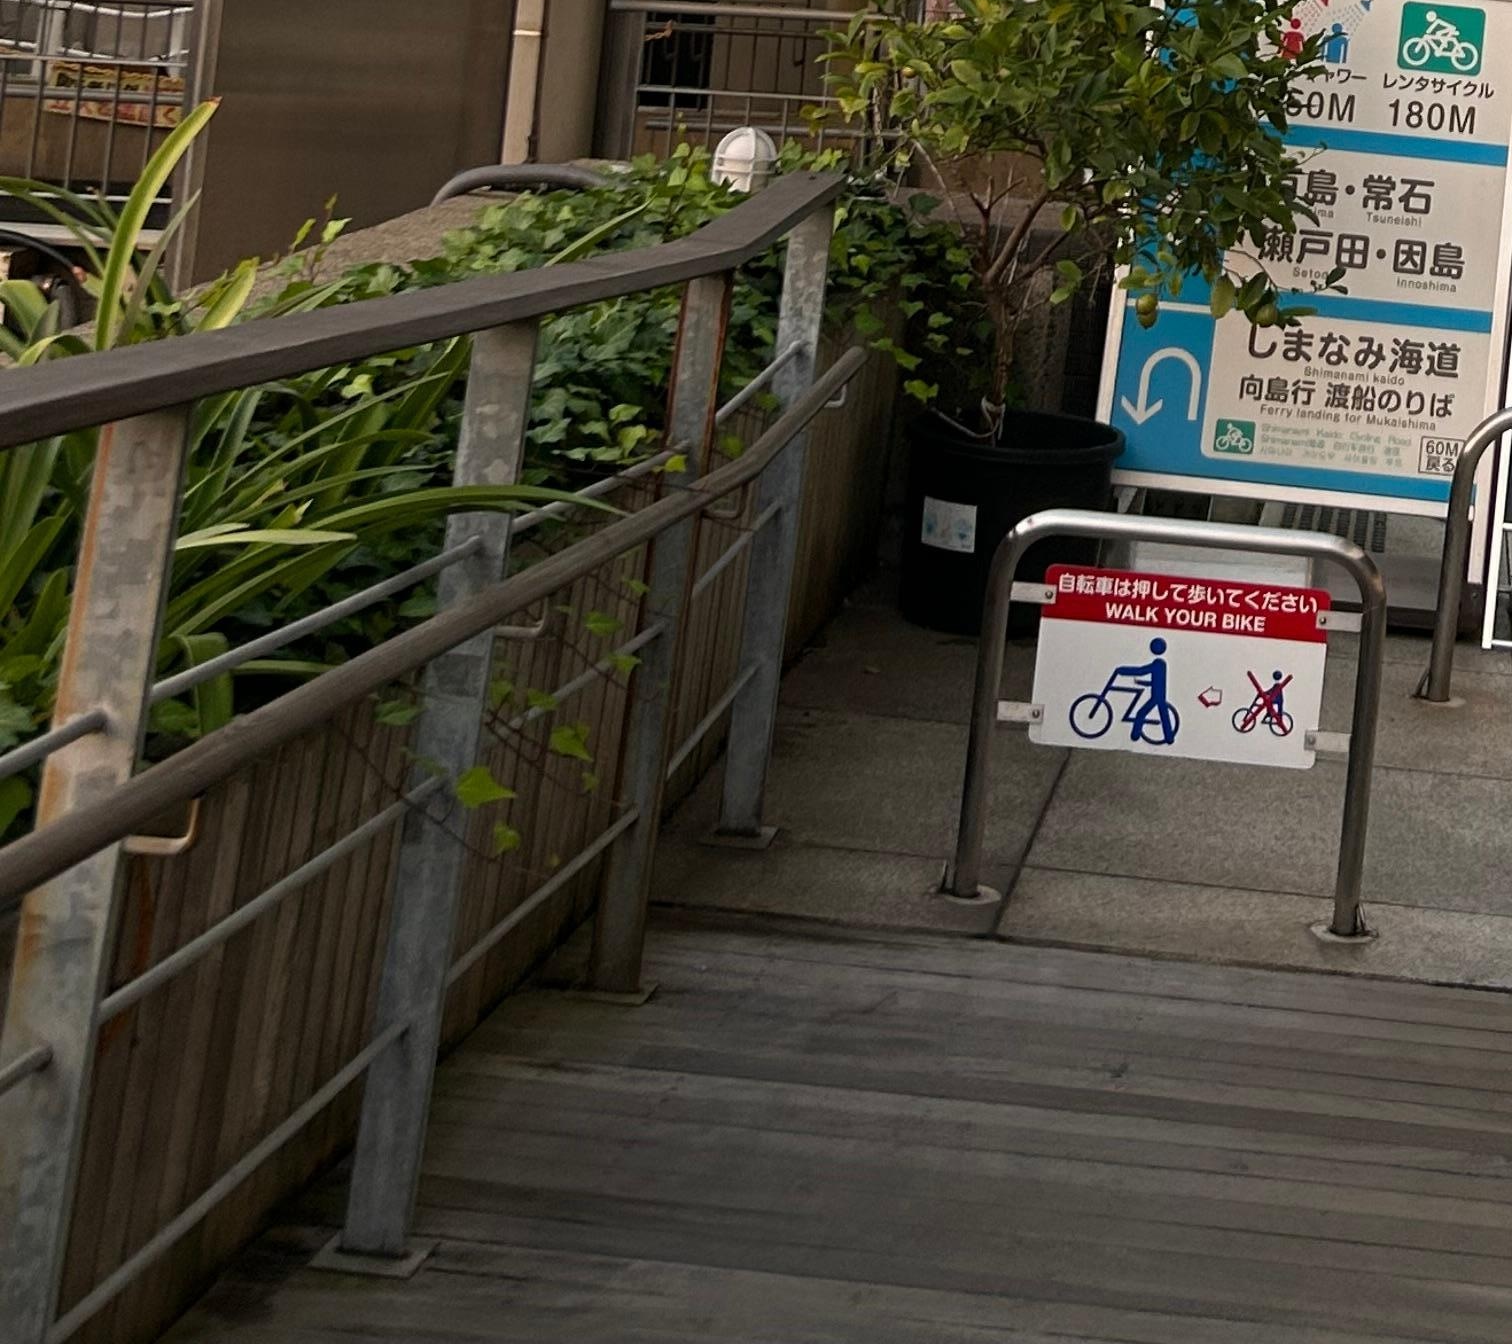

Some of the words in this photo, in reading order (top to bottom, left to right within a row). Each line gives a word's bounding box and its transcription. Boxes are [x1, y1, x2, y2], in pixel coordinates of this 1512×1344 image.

[1383, 73, 1495, 99] レンタサイクル
[1389, 98, 1476, 134] 180M
[1366, 211, 1422, 227] Tsuneishi
[1258, 227, 1465, 280] 瀬戸田・因島
[1396, 278, 1457, 293] Innoshima
[1247, 321, 1461, 378] しまなみ海道
[1304, 366, 1369, 382] Shimanami
[1373, 372, 1405, 386] kaido
[1239, 373, 1316, 406] 向島行
[1324, 380, 1456, 418] 渡船のりば
[1260, 403, 1293, 419] Ferry
[1296, 409, 1340, 422] landing
[1345, 413, 1361, 423] for
[1366, 416, 1436, 432] Mukaishima
[1426, 439, 1459, 457] 60M
[1426, 455, 1455, 473] 戻る
[1058, 573, 1319, 614] 自転車は押して歩いてください
[1105, 602, 1157, 622] WALK
[1164, 609, 1217, 628] YOUR
[1222, 615, 1266, 632] BIKE
